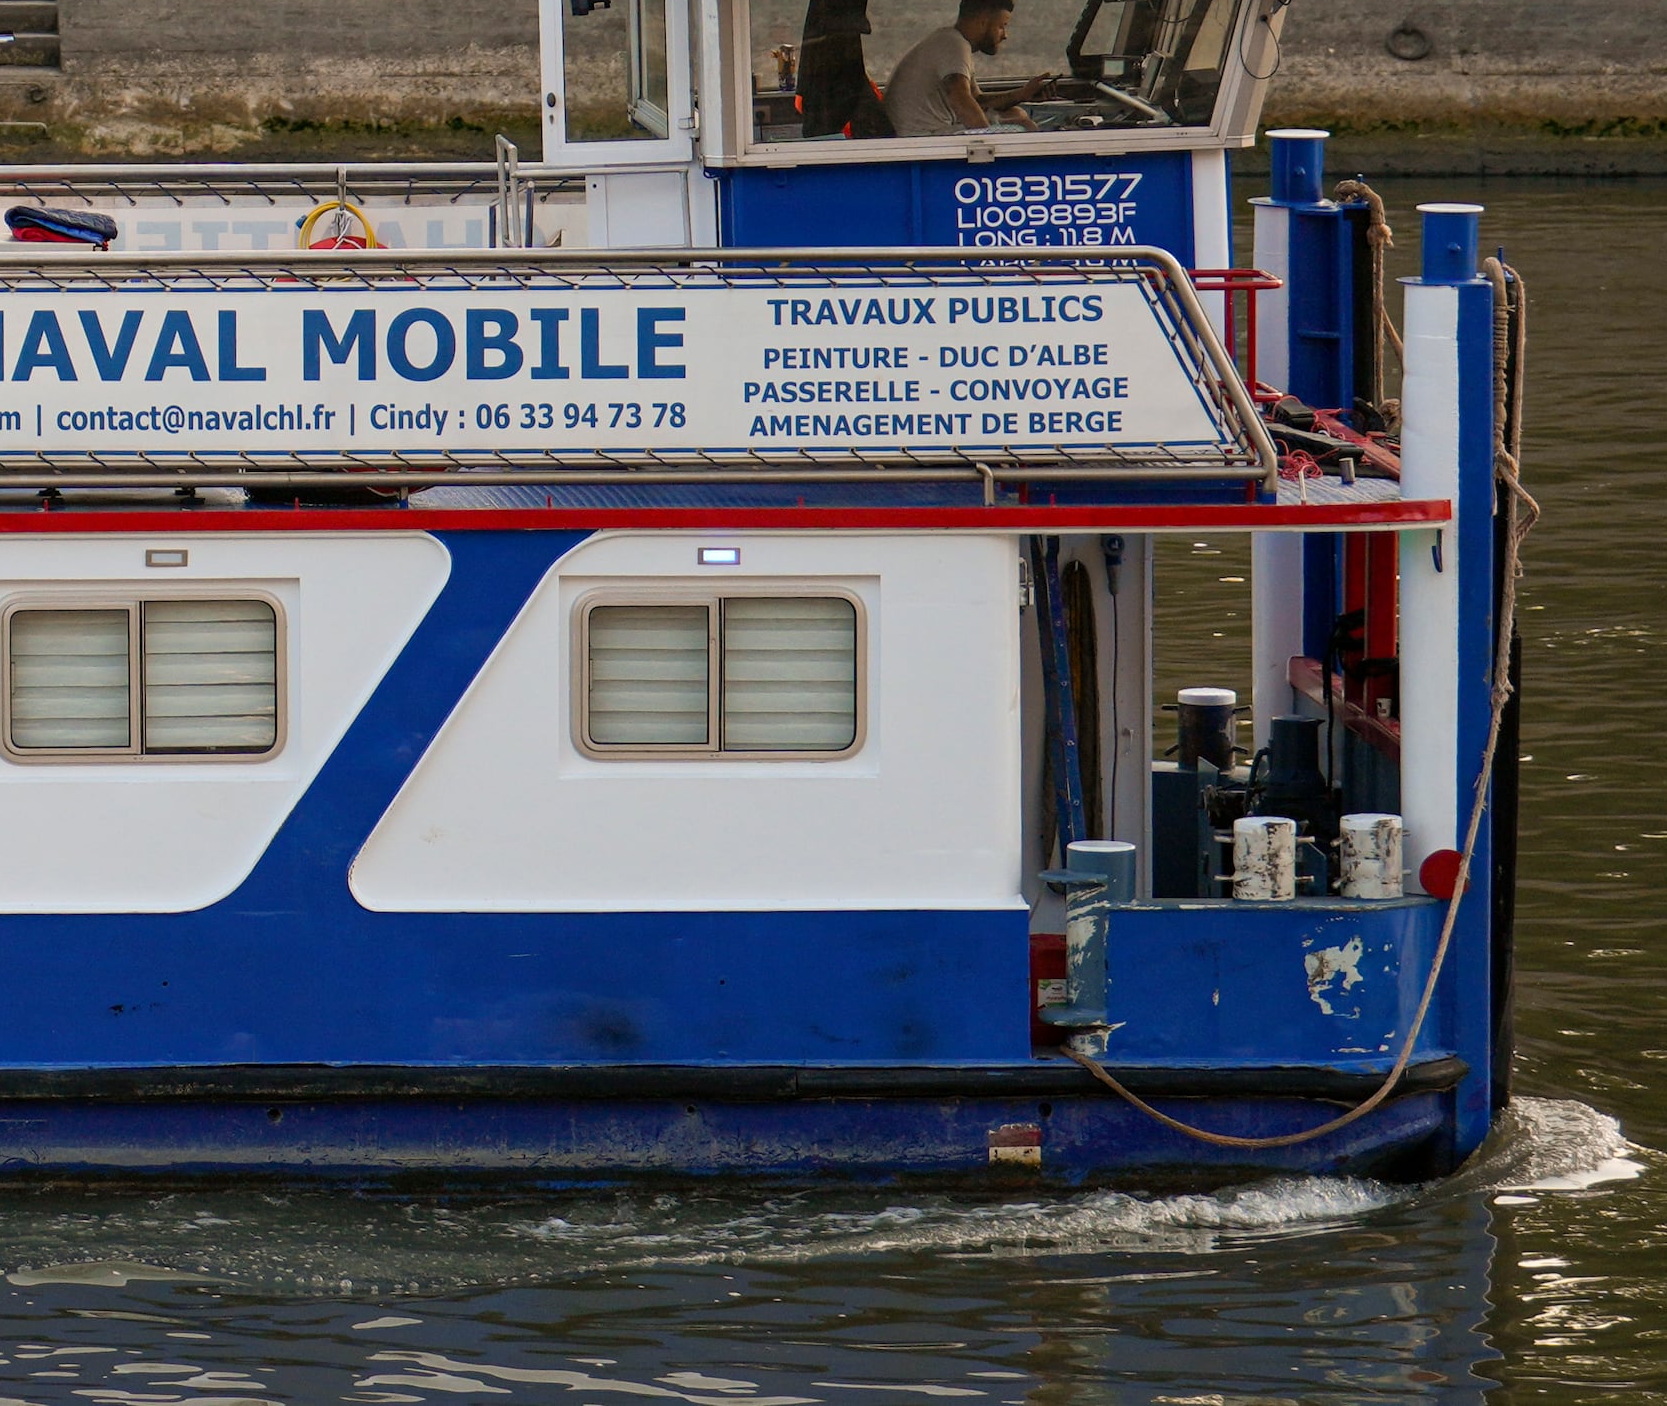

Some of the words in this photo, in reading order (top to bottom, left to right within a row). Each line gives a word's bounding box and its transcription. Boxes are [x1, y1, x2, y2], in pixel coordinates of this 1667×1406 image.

[954, 173, 1143, 204] 01831577
[1059, 227, 1103, 246] 11.8
[1110, 226, 1137, 245] M
[767, 298, 935, 326] TRAVAUX
[949, 295, 1103, 324] PUBLICS
[303, 306, 687, 383] MOBILE
[764, 346, 908, 369] PEINTURE
[939, 345, 998, 368] DUC
[744, 380, 919, 403] PASSERELLE
[950, 377, 1129, 401] CONVOYAGE
[56, 402, 336, 435] contact@navalchl.fr
[369, 402, 448, 436] Cindy
[458, 410, 465, 430] :
[475, 403, 510, 430] 06
[519, 403, 554, 430] 33
[563, 402, 598, 429] 94
[607, 402, 642, 429] 73
[651, 401, 686, 429] 78
[749, 413, 971, 436] AMENAGEMENT
[982, 412, 1017, 435] DE
[1029, 410, 1122, 434] BERGE
